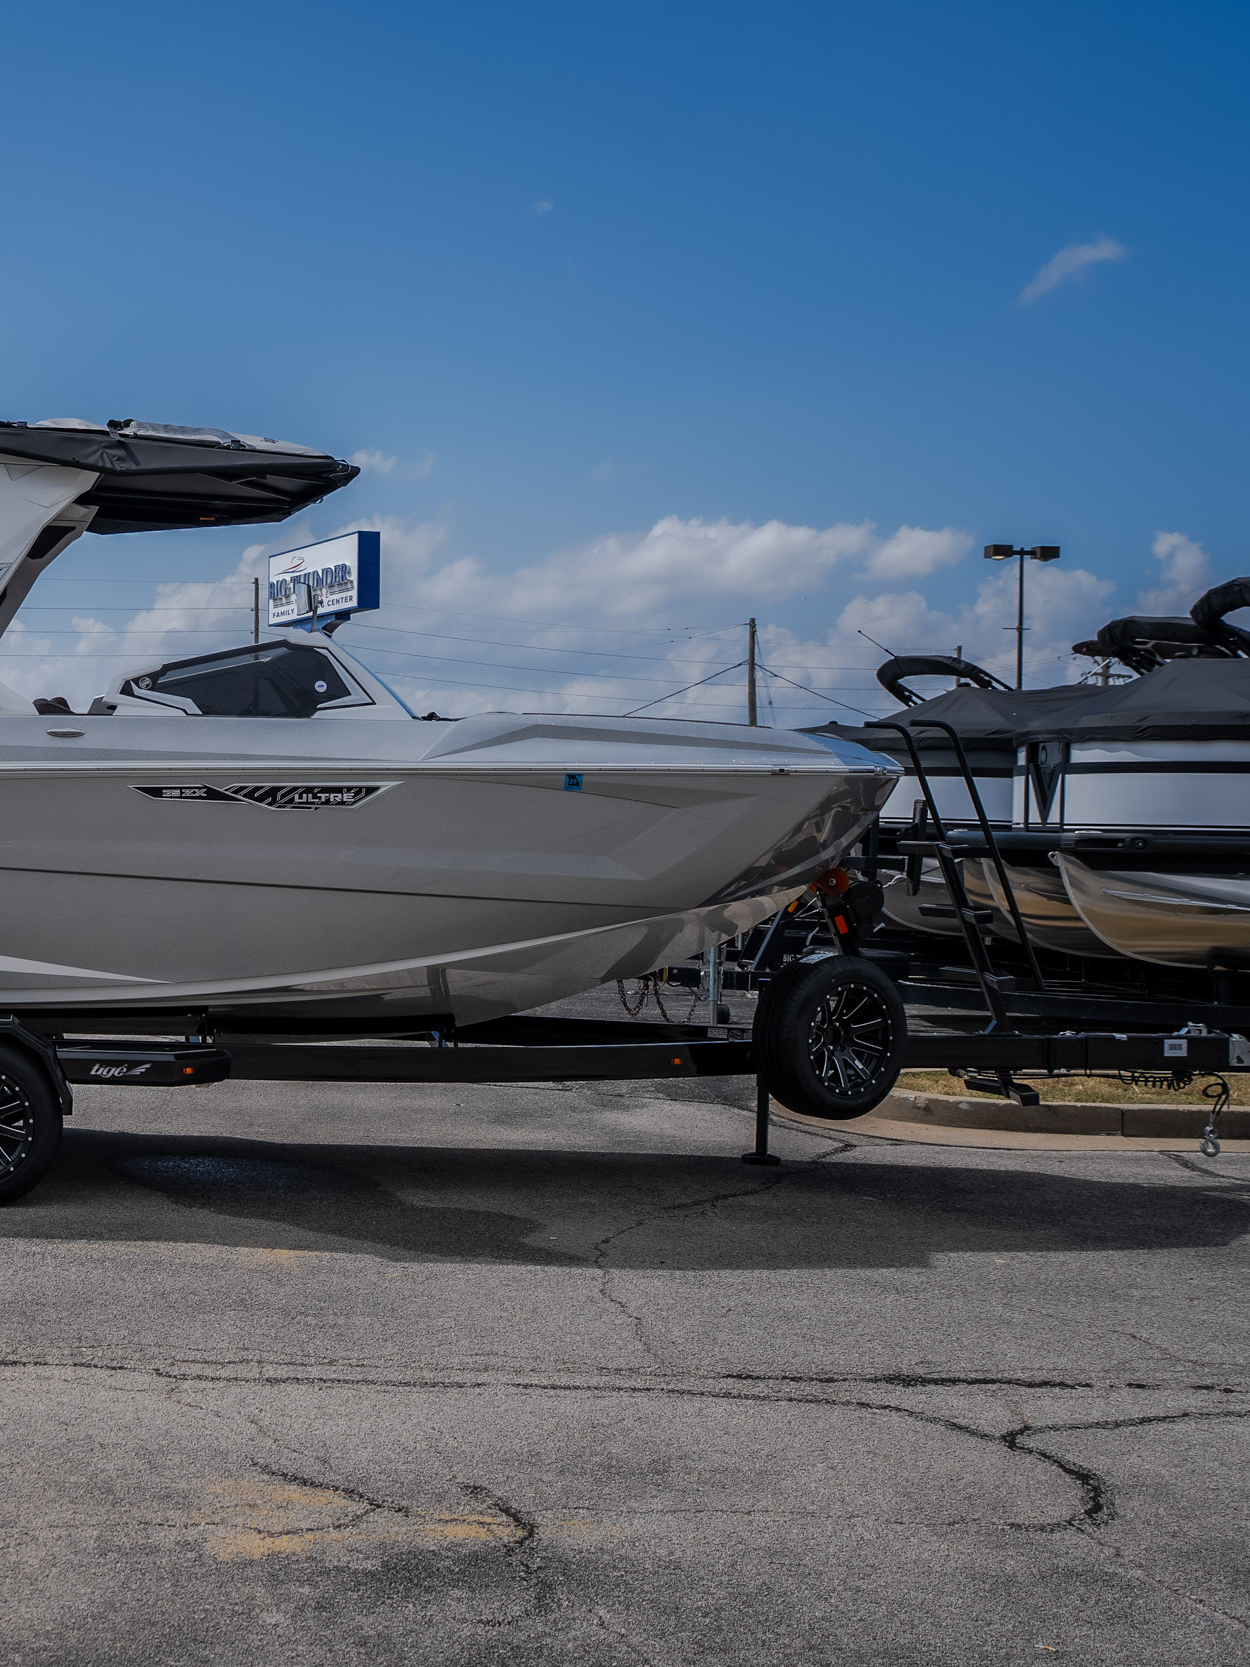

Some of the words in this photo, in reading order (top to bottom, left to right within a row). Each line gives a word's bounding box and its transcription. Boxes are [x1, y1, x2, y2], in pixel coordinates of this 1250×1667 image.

[269, 578, 288, 600] BIG
[273, 608, 295, 618] FAMILY
[327, 595, 353, 607] CENTER
